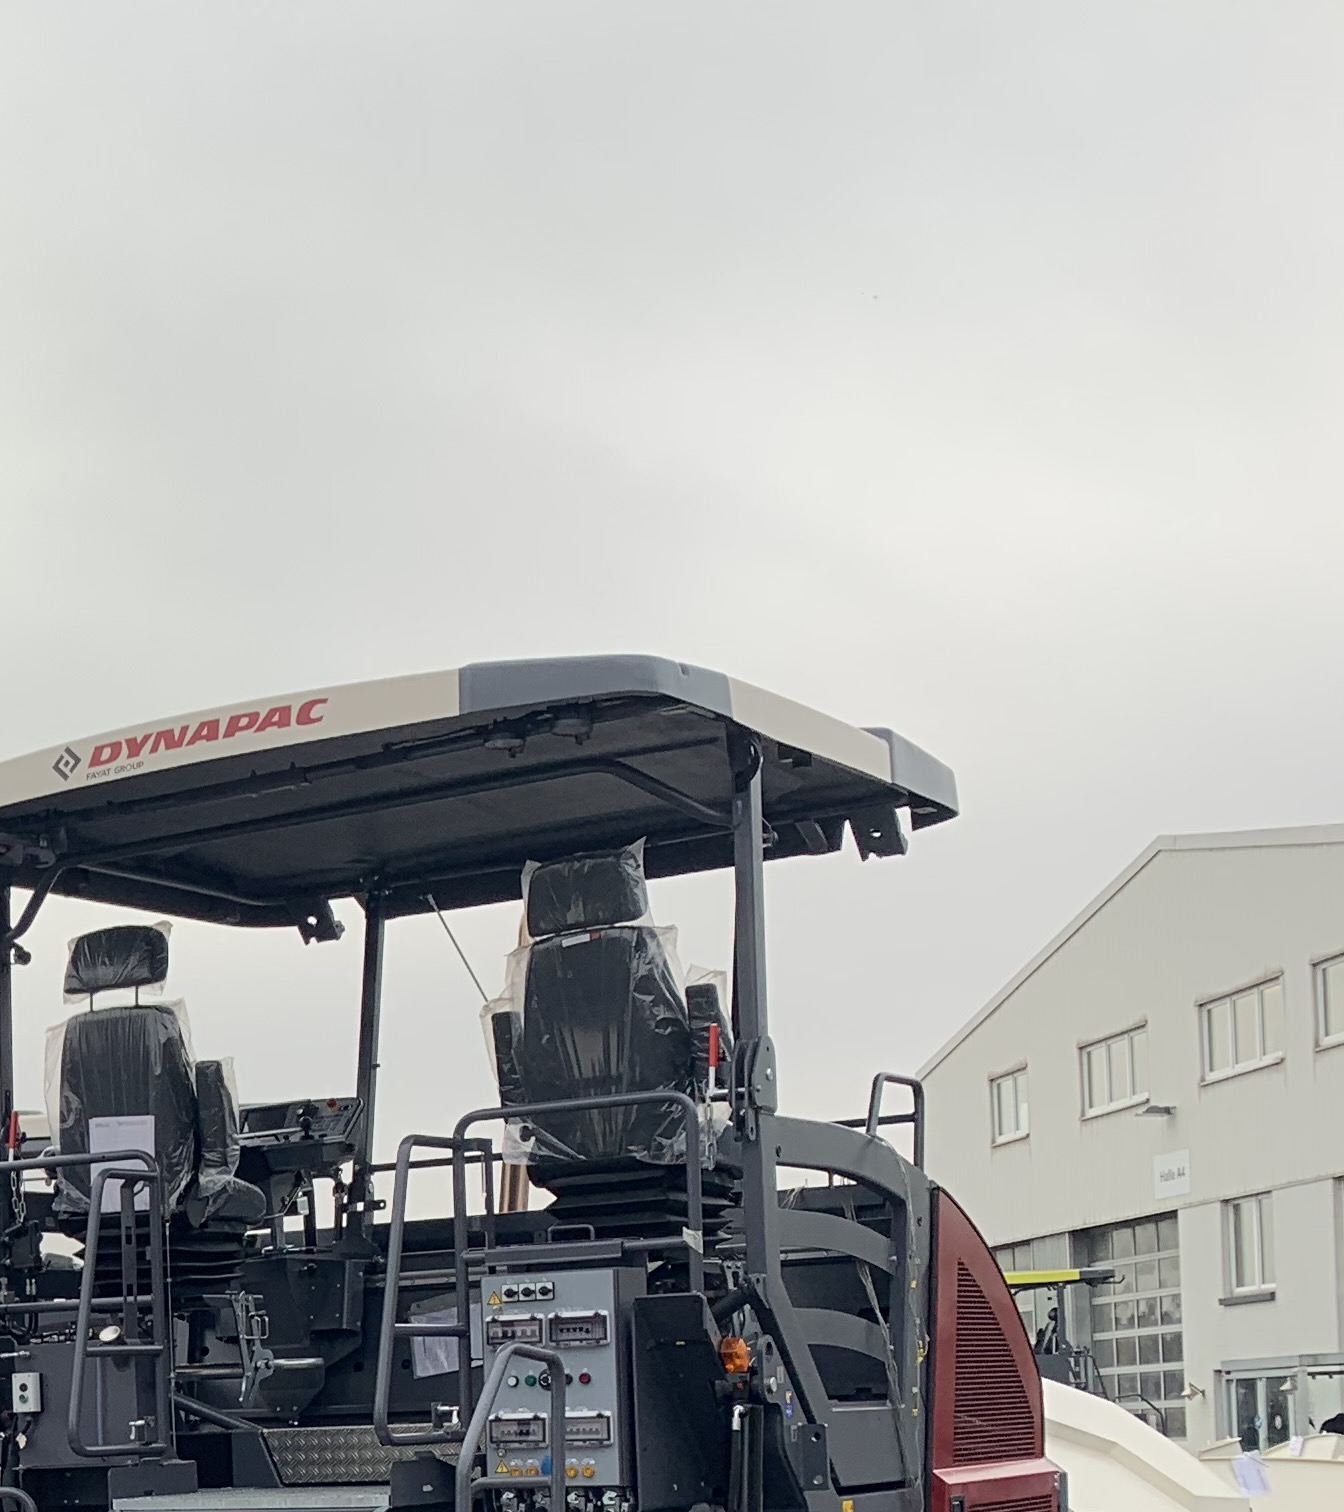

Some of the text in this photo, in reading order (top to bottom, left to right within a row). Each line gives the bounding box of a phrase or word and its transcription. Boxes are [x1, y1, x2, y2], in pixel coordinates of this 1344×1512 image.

[87, 698, 329, 769] DYNAPAC
[86, 761, 144, 781] FAYAT GROUP
